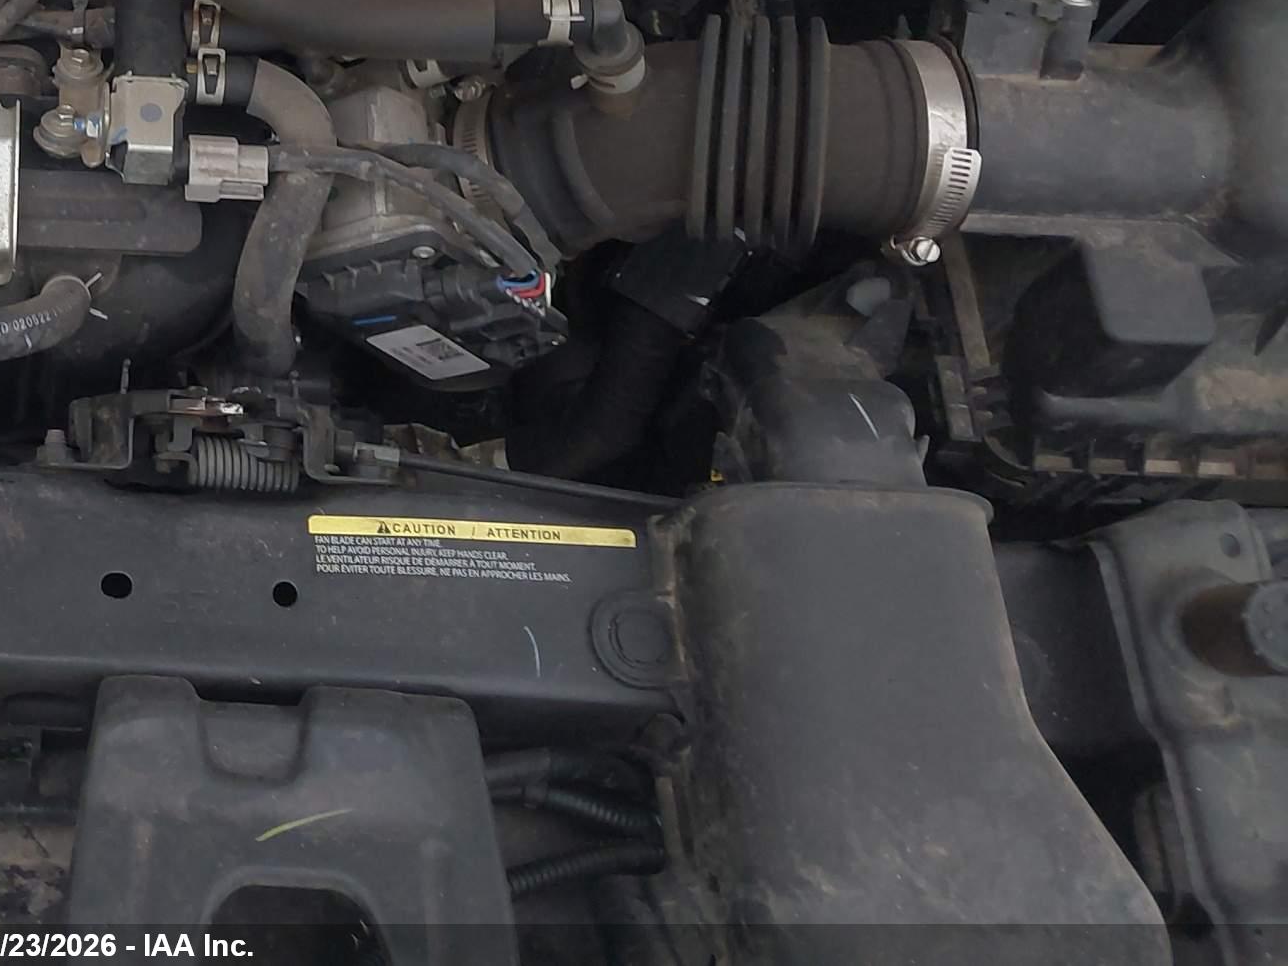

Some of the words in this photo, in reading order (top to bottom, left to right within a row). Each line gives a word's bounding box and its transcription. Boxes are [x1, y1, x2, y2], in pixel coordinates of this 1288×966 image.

[392, 523, 456, 535] CAUTION
[487, 527, 561, 541] ATTENTION
[314, 535, 329, 544] FAN
[331, 535, 355, 545] BLADE
[355, 536, 372, 545] CAN
[373, 537, 395, 546] START
[395, 537, 405, 546] AT
[406, 537, 423, 547] ANY
[315, 544, 327, 554] TO
[328, 545, 346, 554] HELP
[346, 545, 371, 554] AVOID
[372, 545, 409, 556] PERSONAL
[456, 549, 482, 559] HANDS
[315, 553, 325, 563] LE
[325, 554, 380, 565] VENTILATEUR
[381, 555, 411, 566] RISQUE
[412, 556, 423, 566] DE
[476, 559, 497, 569] TOUT
[316, 563, 340, 573] POUR
[369, 565, 395, 574] TOUTE
[440, 567, 451, 577] NE
[452, 568, 467, 577] PAS
[468, 569, 480, 578] EN
[480, 569, 528, 581] APPROCHER
[528, 571, 543, 581] LES
